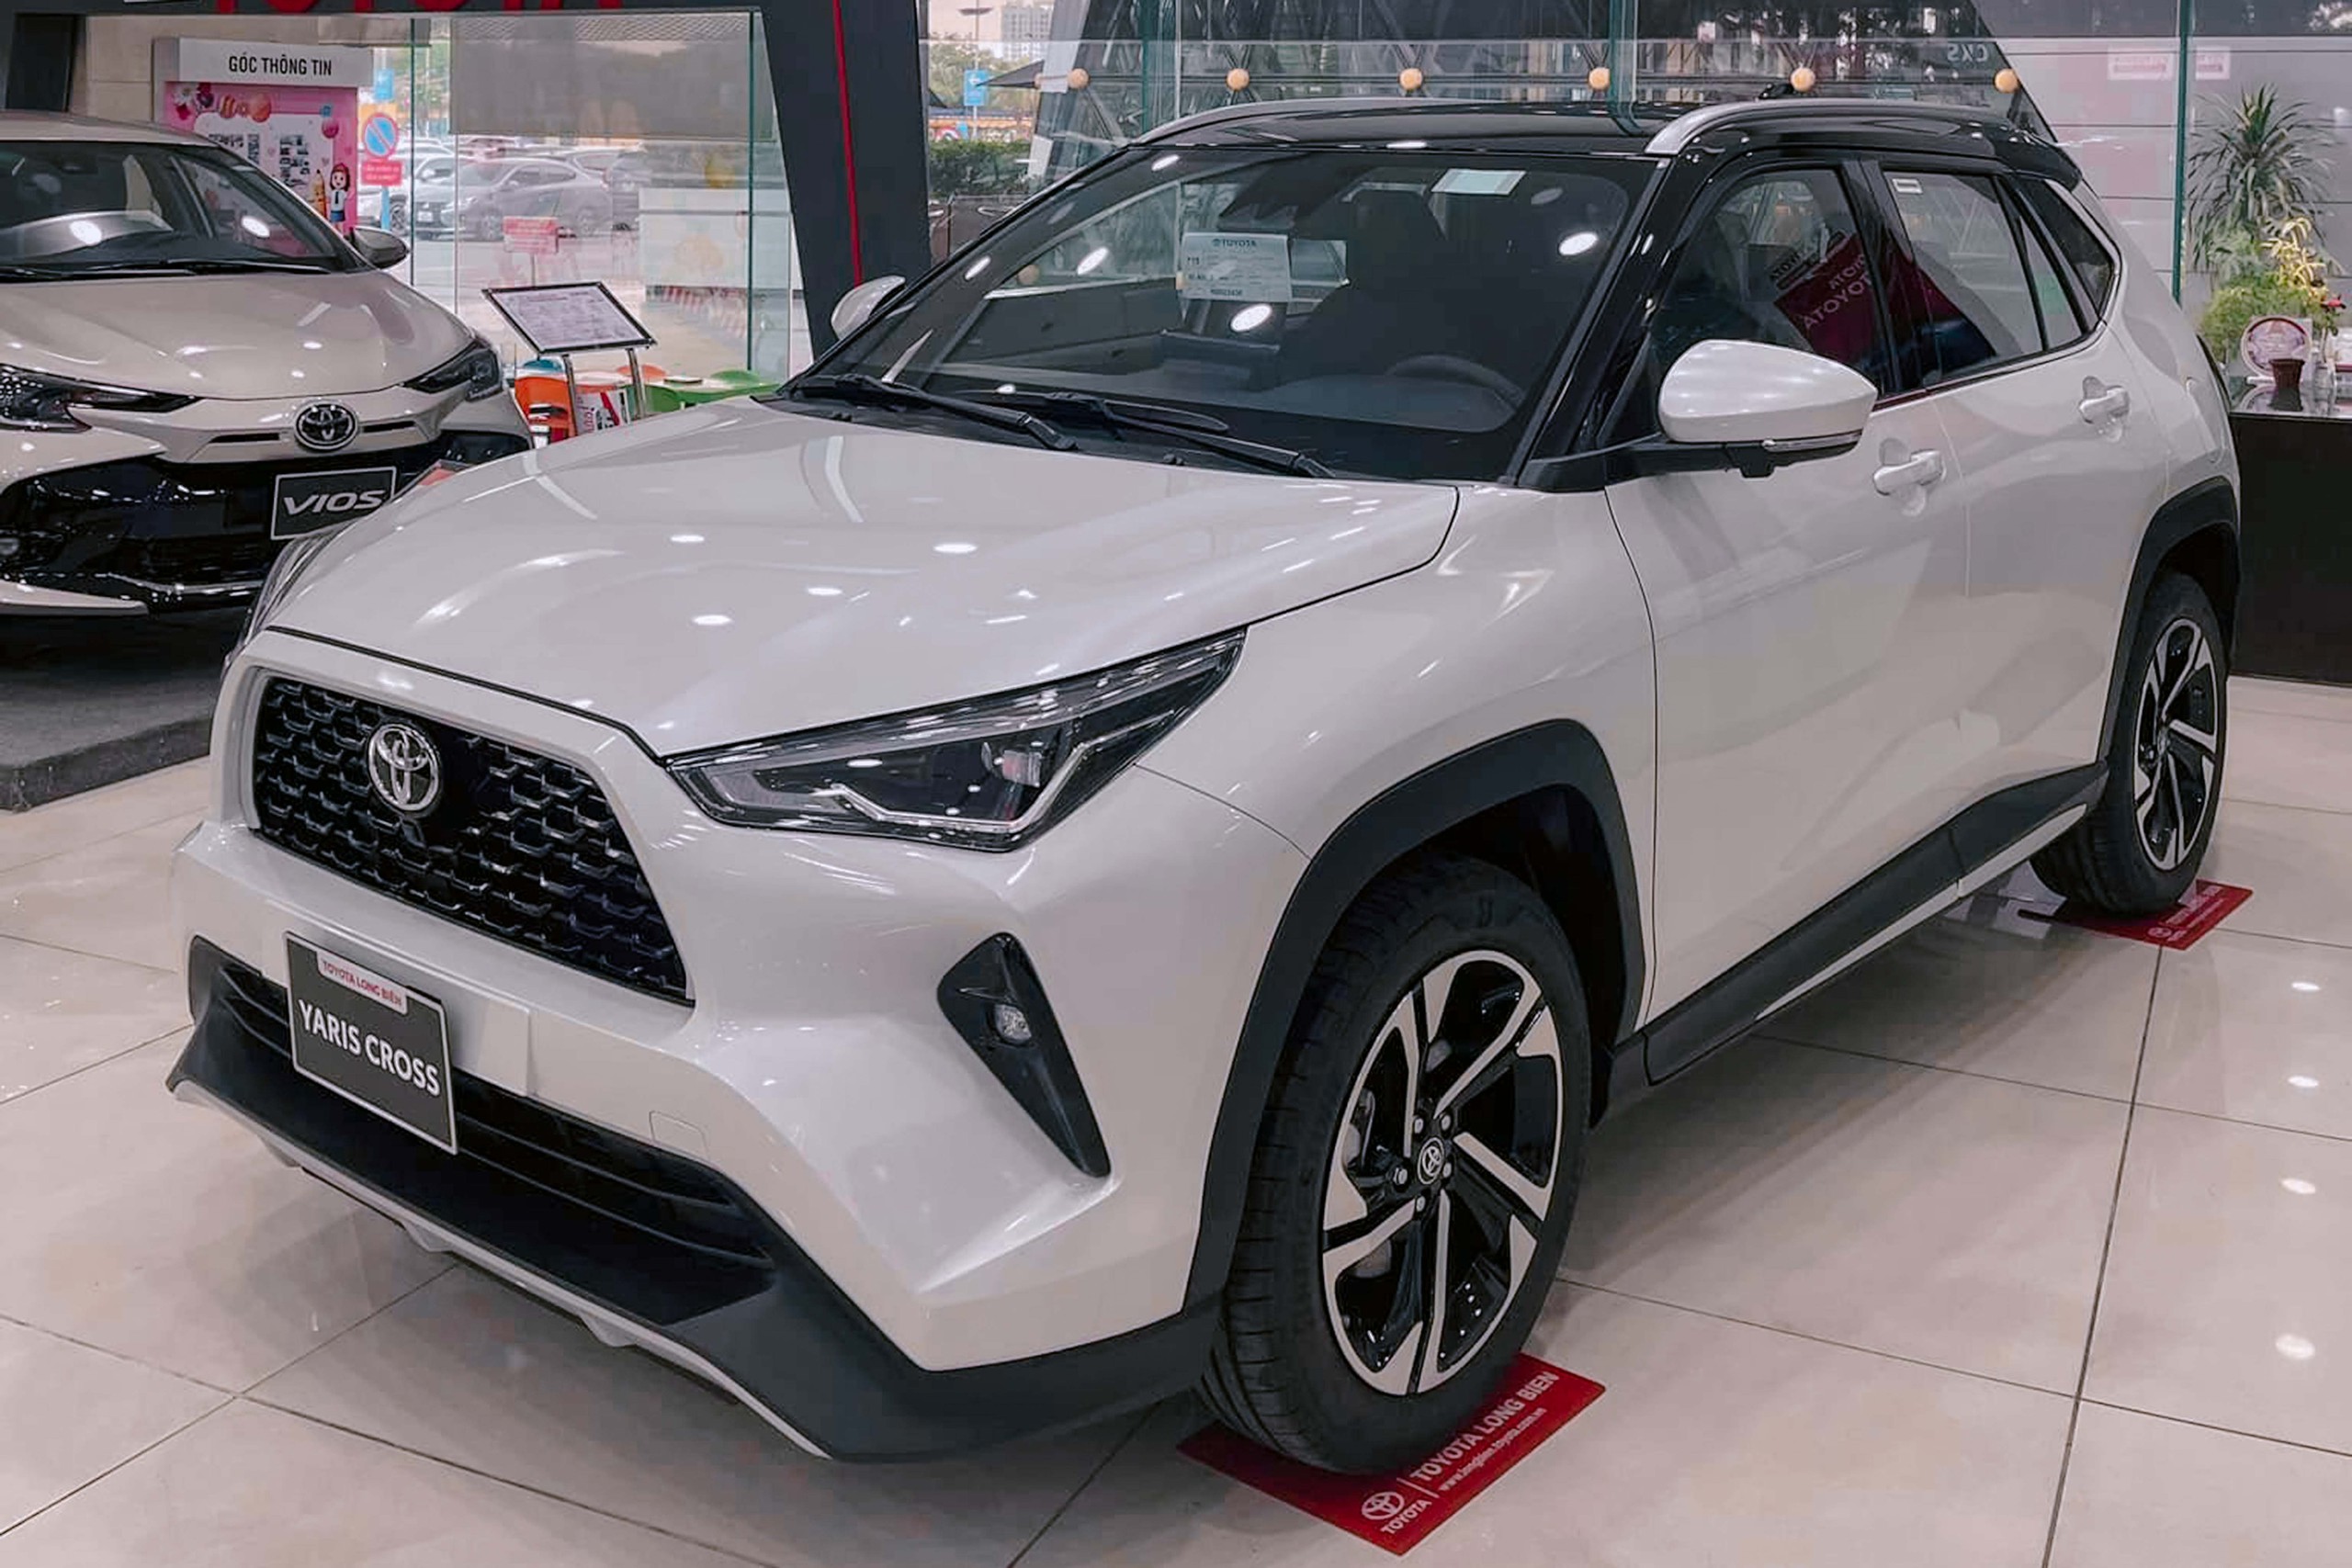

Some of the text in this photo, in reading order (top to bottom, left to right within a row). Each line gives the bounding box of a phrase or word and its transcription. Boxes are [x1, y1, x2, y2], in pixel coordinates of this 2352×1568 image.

[229, 52, 333, 75] GÓC THÔNG TIN
[283, 490, 386, 514] VIOS
[322, 960, 356, 984] TOYOTA
[356, 976, 380, 997] LONG
[298, 998, 441, 1097] YARIS CROSS
[1409, 1431, 1484, 1482] TOYOTA
[1475, 1398, 1526, 1434] LONG
[1381, 1498, 1433, 1535] TOYOTA
